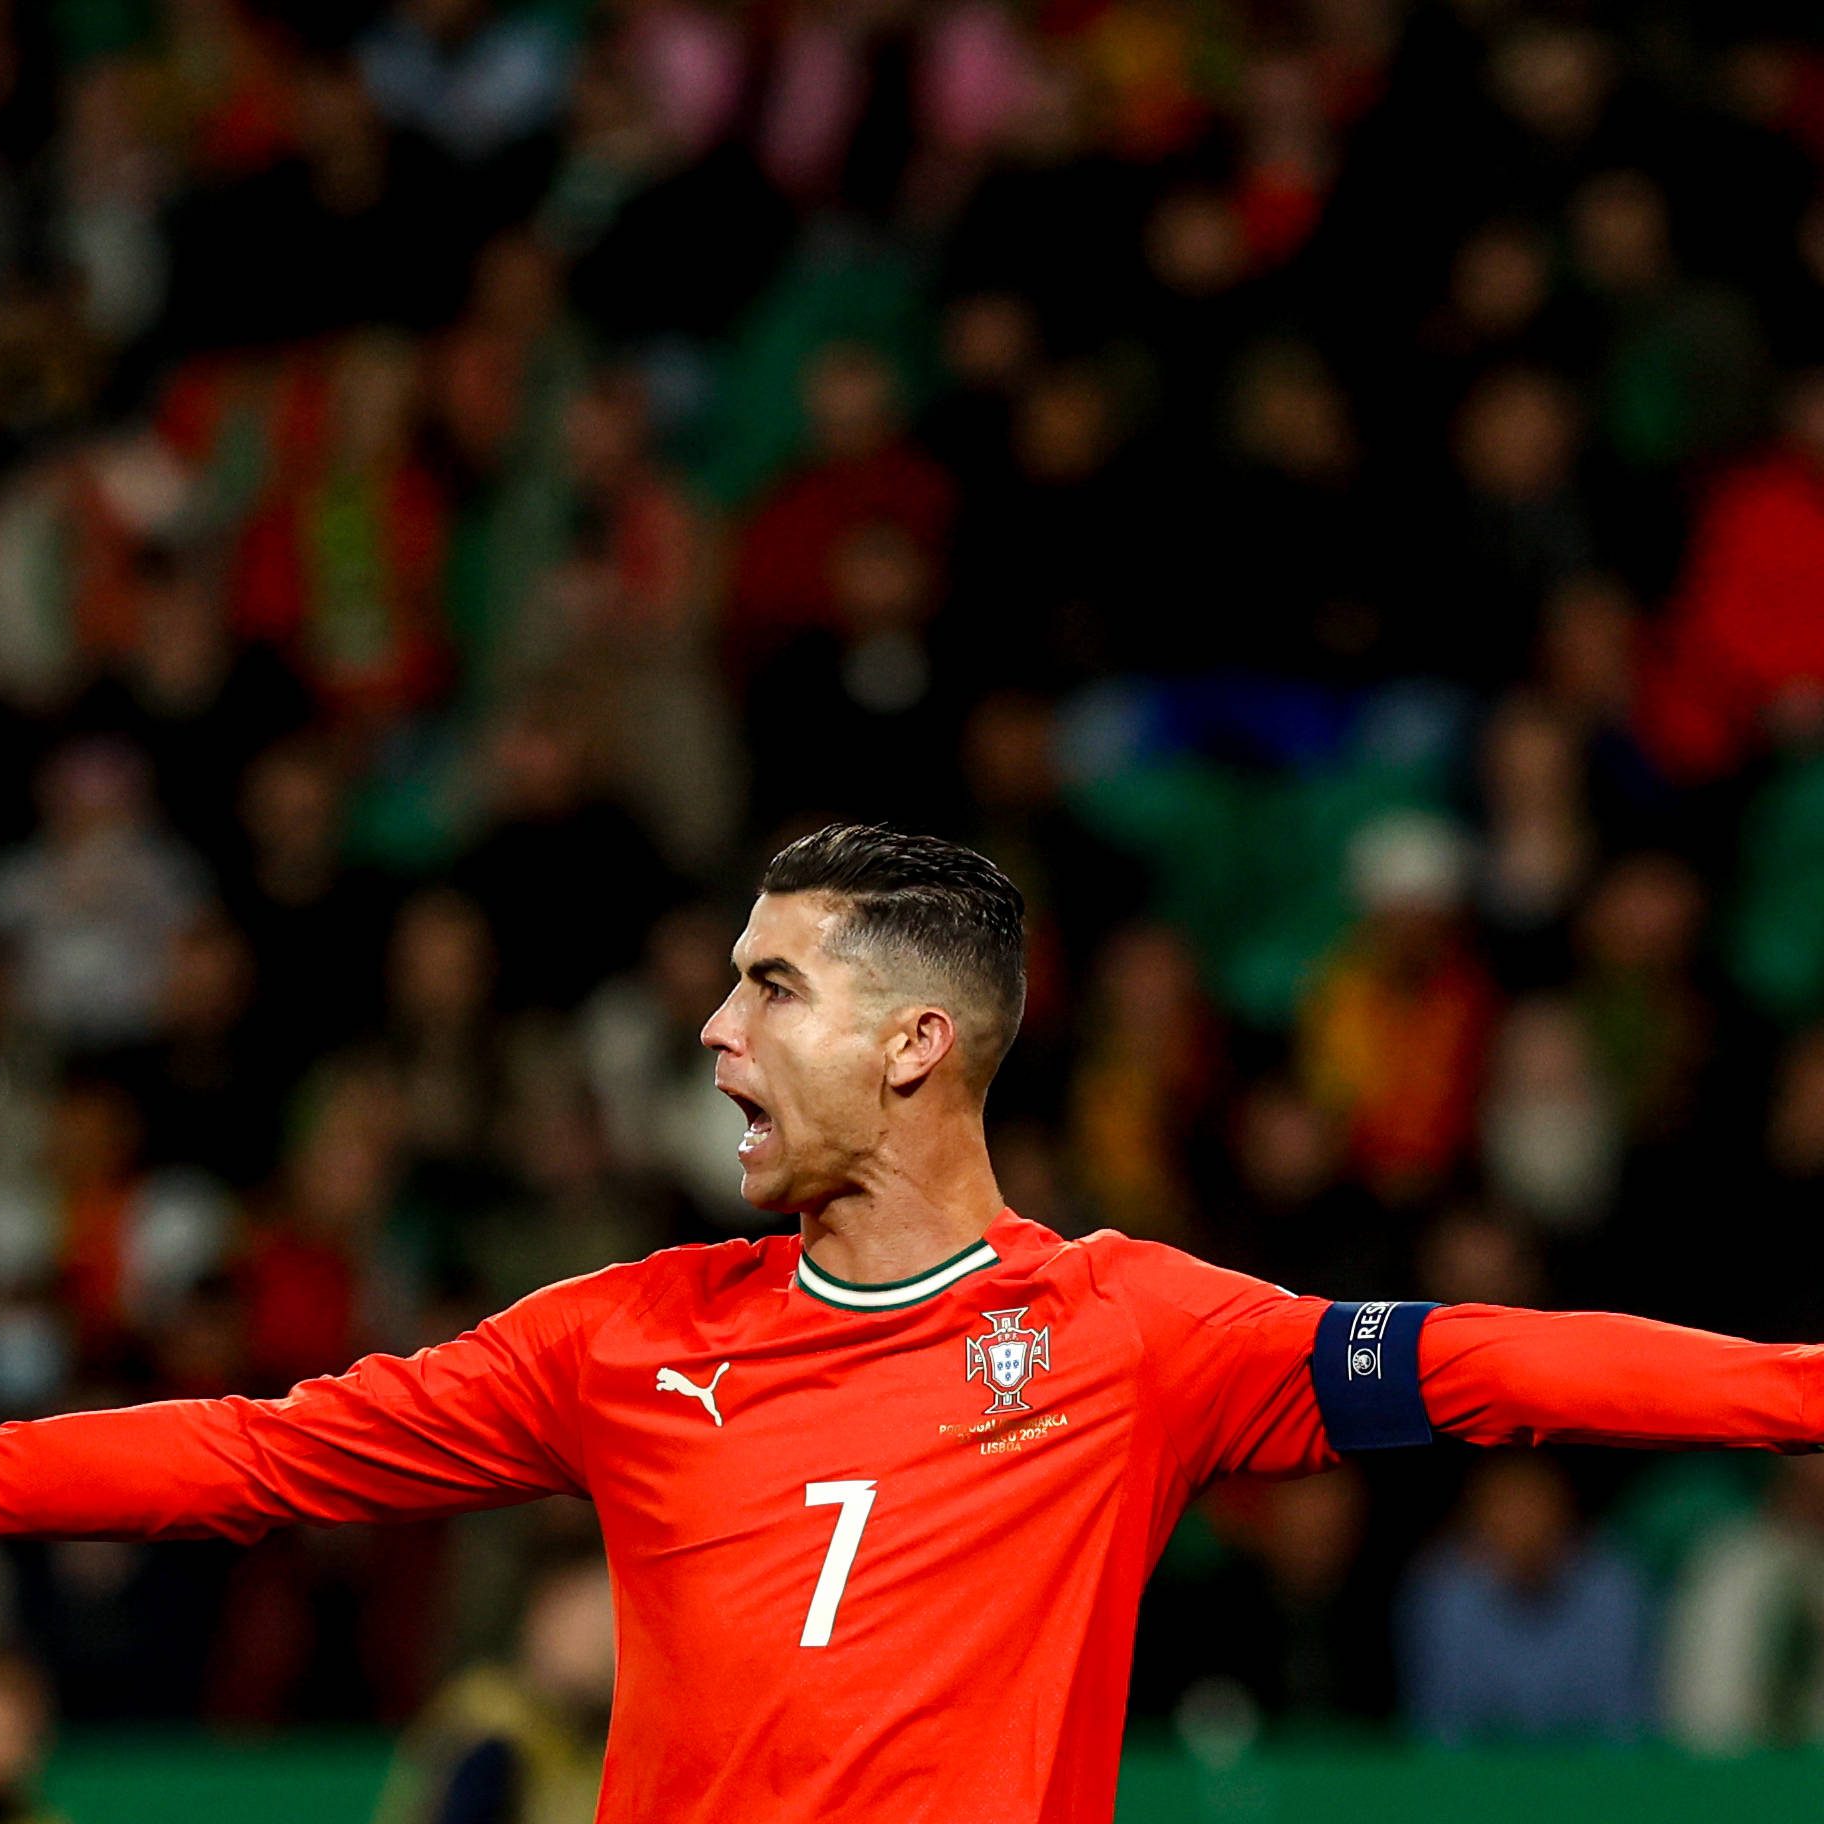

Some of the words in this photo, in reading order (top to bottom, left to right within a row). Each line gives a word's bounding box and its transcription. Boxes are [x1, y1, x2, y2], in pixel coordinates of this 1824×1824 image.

[1019, 1427, 1048, 1441] 2025
[980, 1441, 1022, 1455] LISBOA
[800, 1480, 878, 1647] 7
